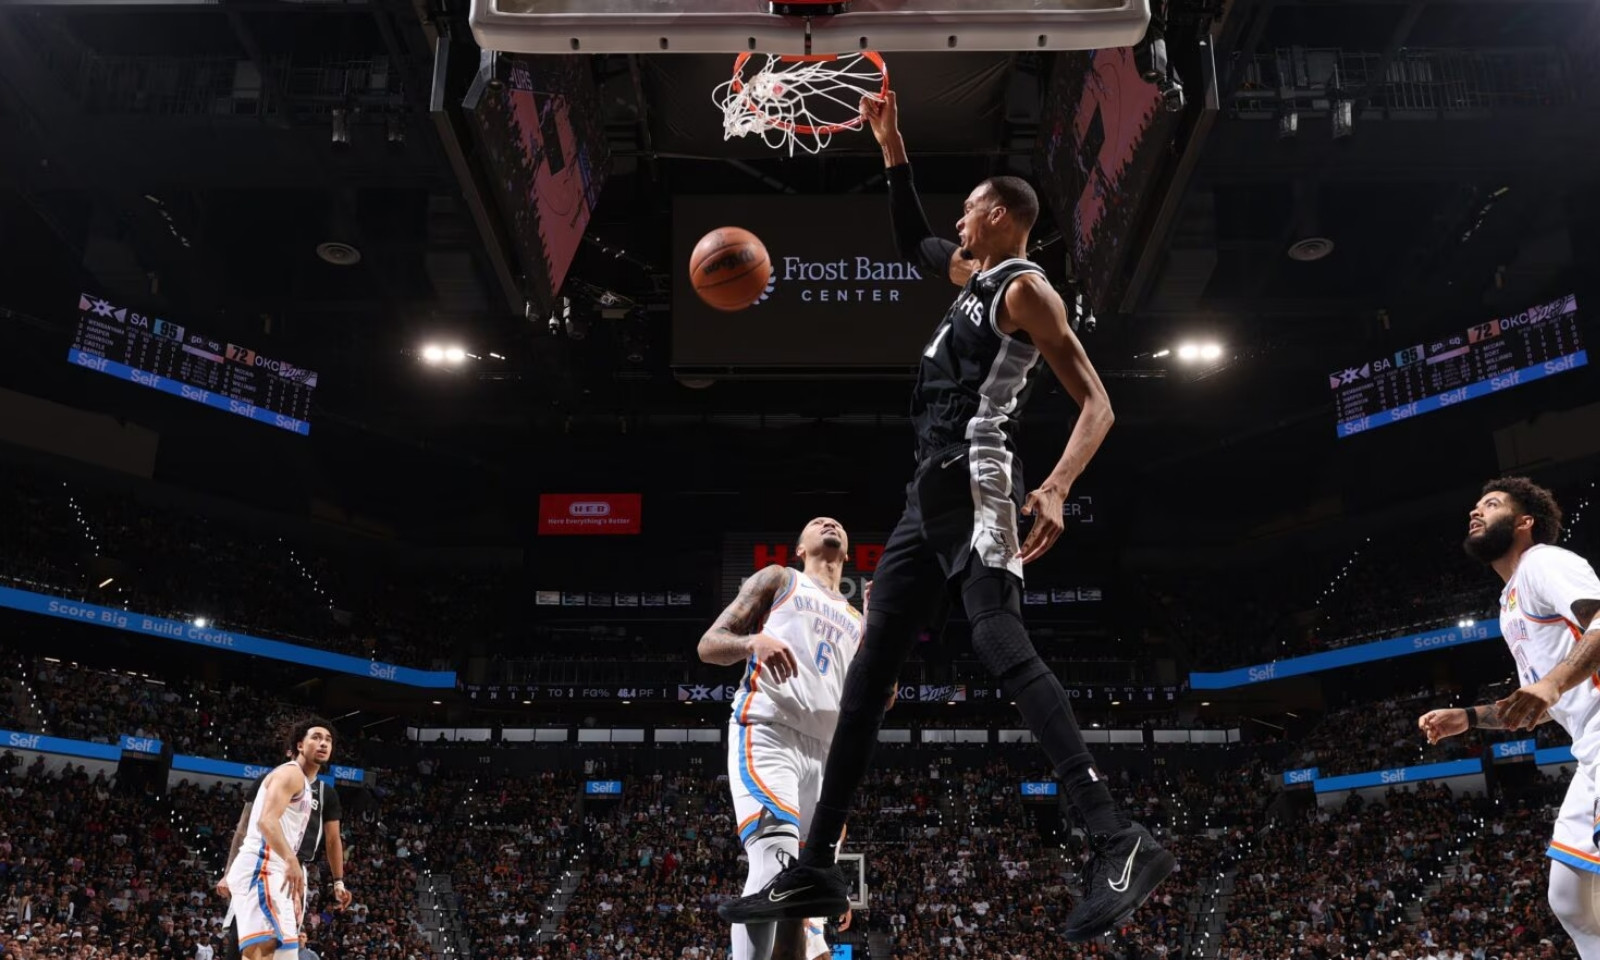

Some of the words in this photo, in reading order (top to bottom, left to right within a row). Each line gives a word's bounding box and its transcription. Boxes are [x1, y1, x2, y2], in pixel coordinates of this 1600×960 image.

[782, 257, 848, 281] Frost
[854, 257, 923, 281] Bank
[801, 290, 900, 302] CENTER
[129, 312, 149, 328] SA
[159, 321, 178, 339] 95
[231, 346, 248, 362] 72
[254, 355, 279, 373] OKC
[1373, 356, 1390, 372] SA
[1401, 348, 1418, 364] 95
[1474, 323, 1492, 340] 72
[1499, 311, 1529, 330] OKC
[76, 352, 108, 372] Self
[1543, 354, 1576, 375] Self
[129, 368, 160, 388] Self
[1489, 371, 1521, 391] Self
[180, 383, 209, 403] Self
[1438, 387, 1468, 406] Self
[229, 399, 256, 418] Self
[1391, 401, 1418, 421] Self
[275, 414, 301, 432] Self
[1344, 416, 1371, 435] Self
[48, 601, 96, 619] Score
[101, 611, 127, 628] Big
[142, 619, 183, 636] Build
[187, 628, 234, 646] Credit
[793, 595, 860, 643] OKLAHOMA
[813, 618, 842, 643] CITY
[816, 640, 832, 676] 6
[1248, 663, 1276, 681] Self
[1413, 632, 1457, 649] Score
[1461, 624, 1488, 641] Big
[369, 662, 396, 679] Self
[547, 688, 563, 697] TO
[582, 688, 610, 697] FG%
[639, 689, 654, 697] PF
[725, 686, 736, 699] S
[897, 686, 915, 699] KC
[973, 689, 988, 698] PF
[9, 732, 40, 749] Self
[125, 737, 154, 752] Self
[1500, 741, 1526, 755] Self
[335, 766, 358, 780] Self
[1289, 770, 1311, 783] Self
[1380, 770, 1406, 784] Self
[592, 782, 614, 793] Self
[1027, 784, 1049, 795] Self
